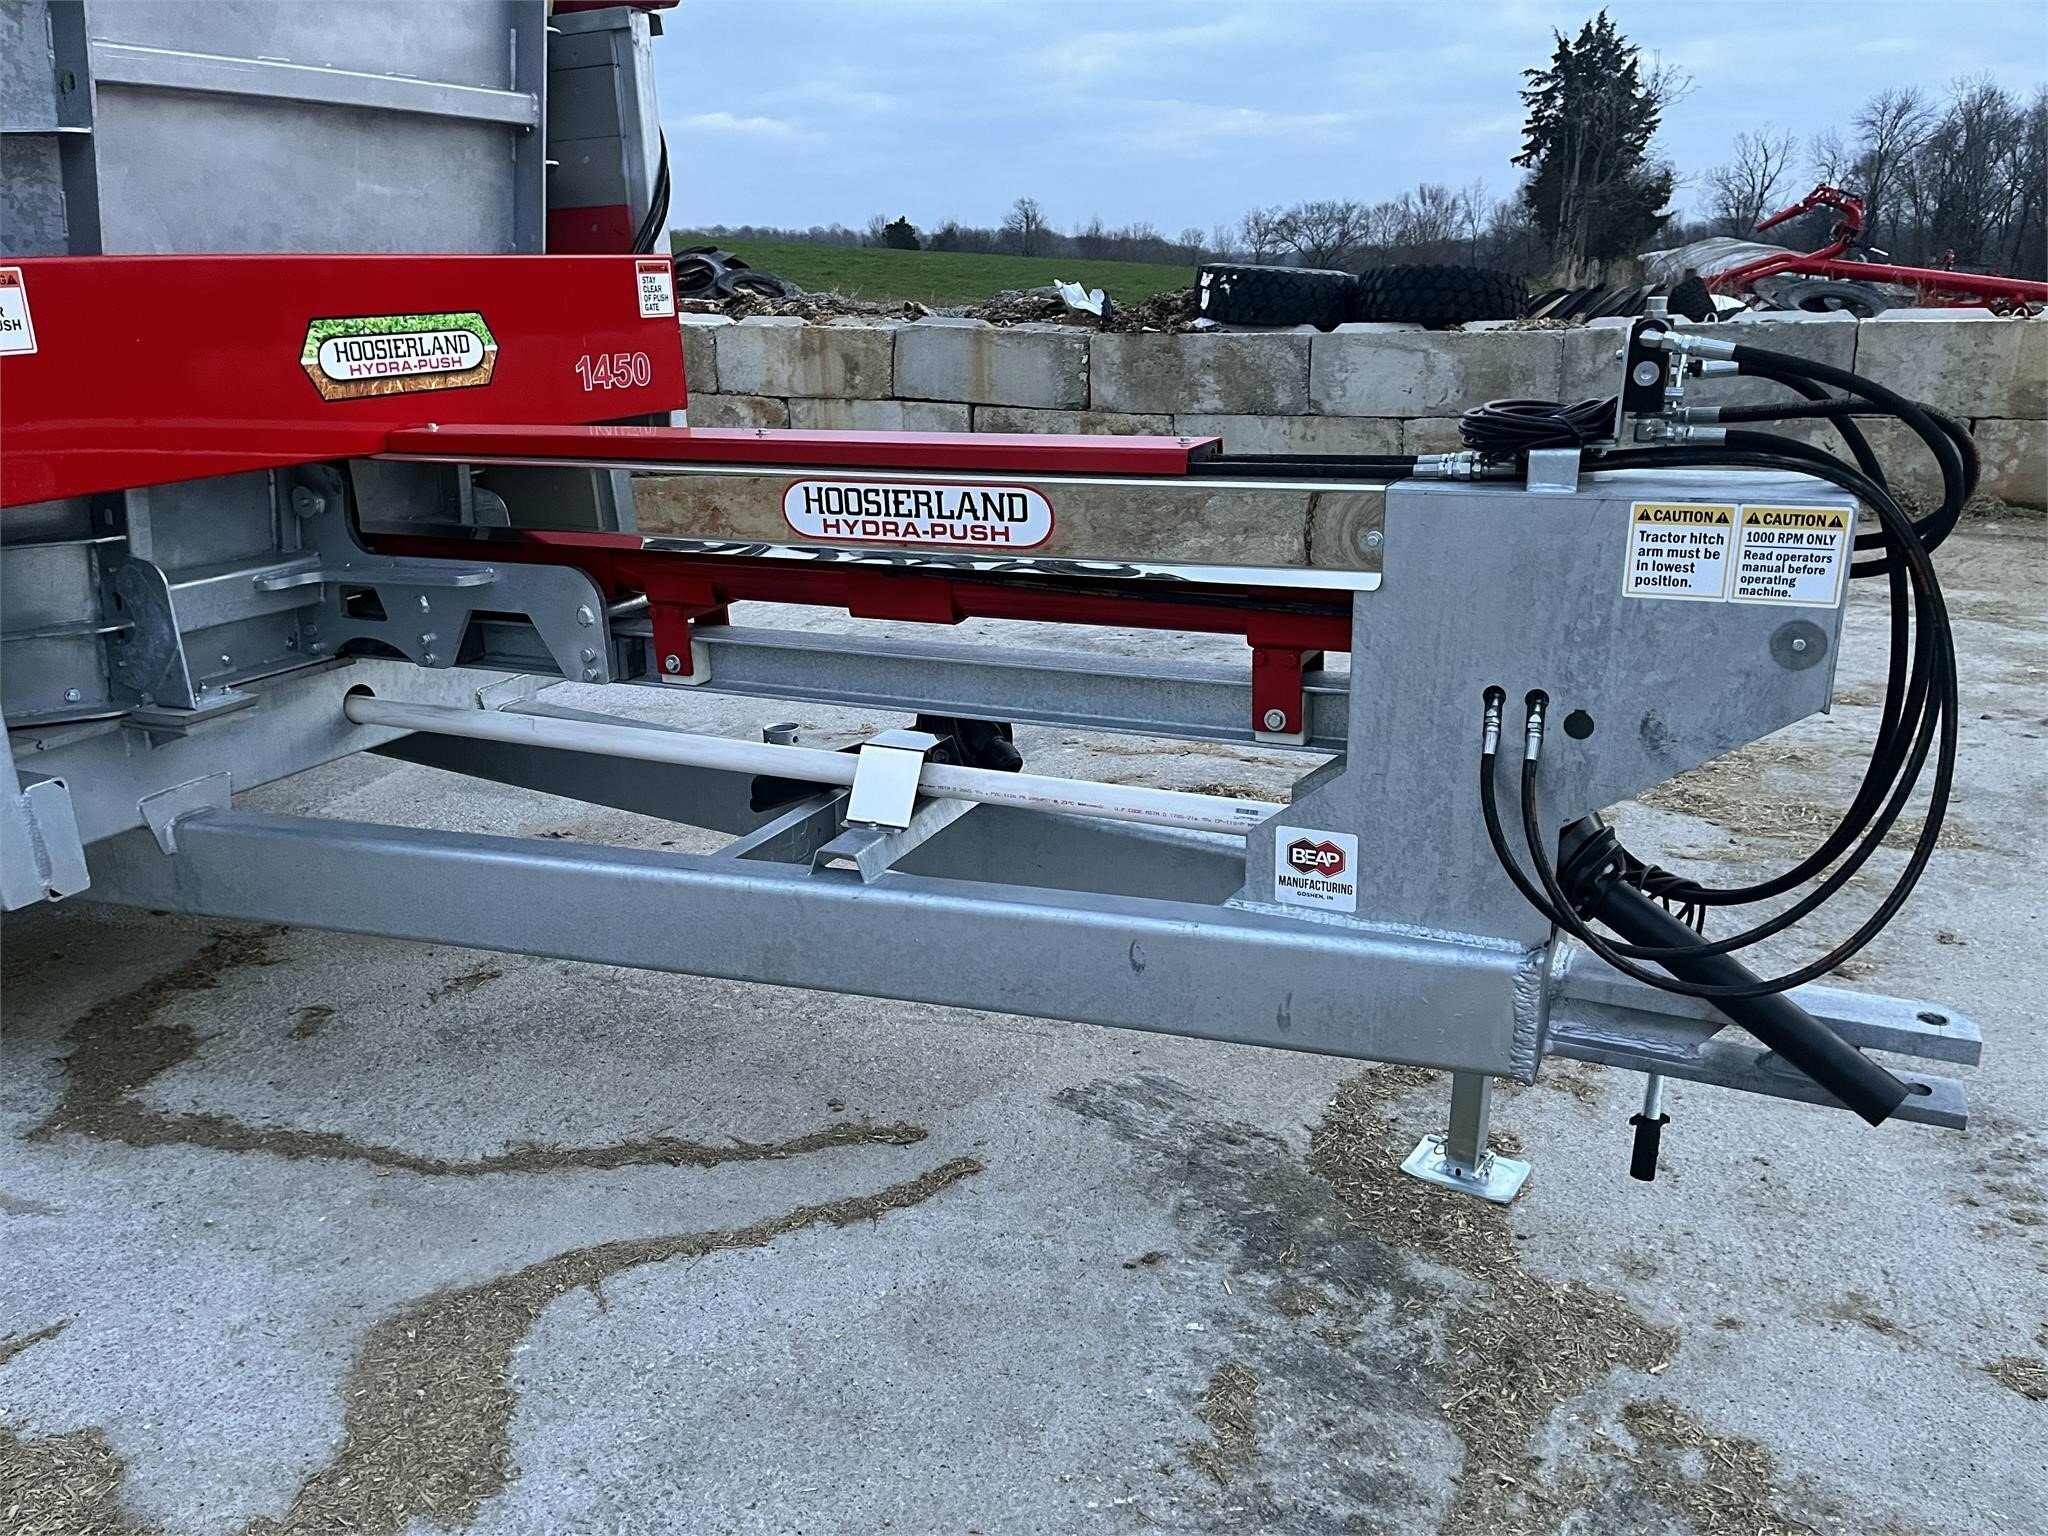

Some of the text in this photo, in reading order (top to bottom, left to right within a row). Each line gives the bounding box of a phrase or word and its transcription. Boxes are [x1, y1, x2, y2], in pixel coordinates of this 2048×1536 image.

[642, 276, 656, 284] STAY
[643, 285, 662, 293] CLEAR
[643, 294, 669, 302] OF PUSH
[644, 303, 660, 311] GATE
[333, 334, 470, 363] HOOSIERLAND
[349, 356, 463, 376] HYDRA-PUSH
[575, 351, 651, 391] 1450
[803, 486, 1029, 523] HOOSIERLAND
[1653, 509, 1714, 523] CAUTION
[1763, 512, 1827, 527] CAUTION
[823, 518, 1010, 542] HYDRA-PUSH
[1639, 530, 1724, 545] Tractor hitch
[1746, 531, 1837, 546] 1000 RPM ONLY
[1637, 547, 1721, 560] arm must be
[1743, 549, 1833, 564] Read operators
[1636, 559, 1695, 574] in lowest
[1742, 562, 1826, 575] manual before
[1634, 575, 1692, 588] position.
[1740, 575, 1797, 588] operating
[1739, 586, 1792, 598] machine.
[1292, 847, 1340, 868] BEAP
[1278, 875, 1353, 895] MANUFACTURING
